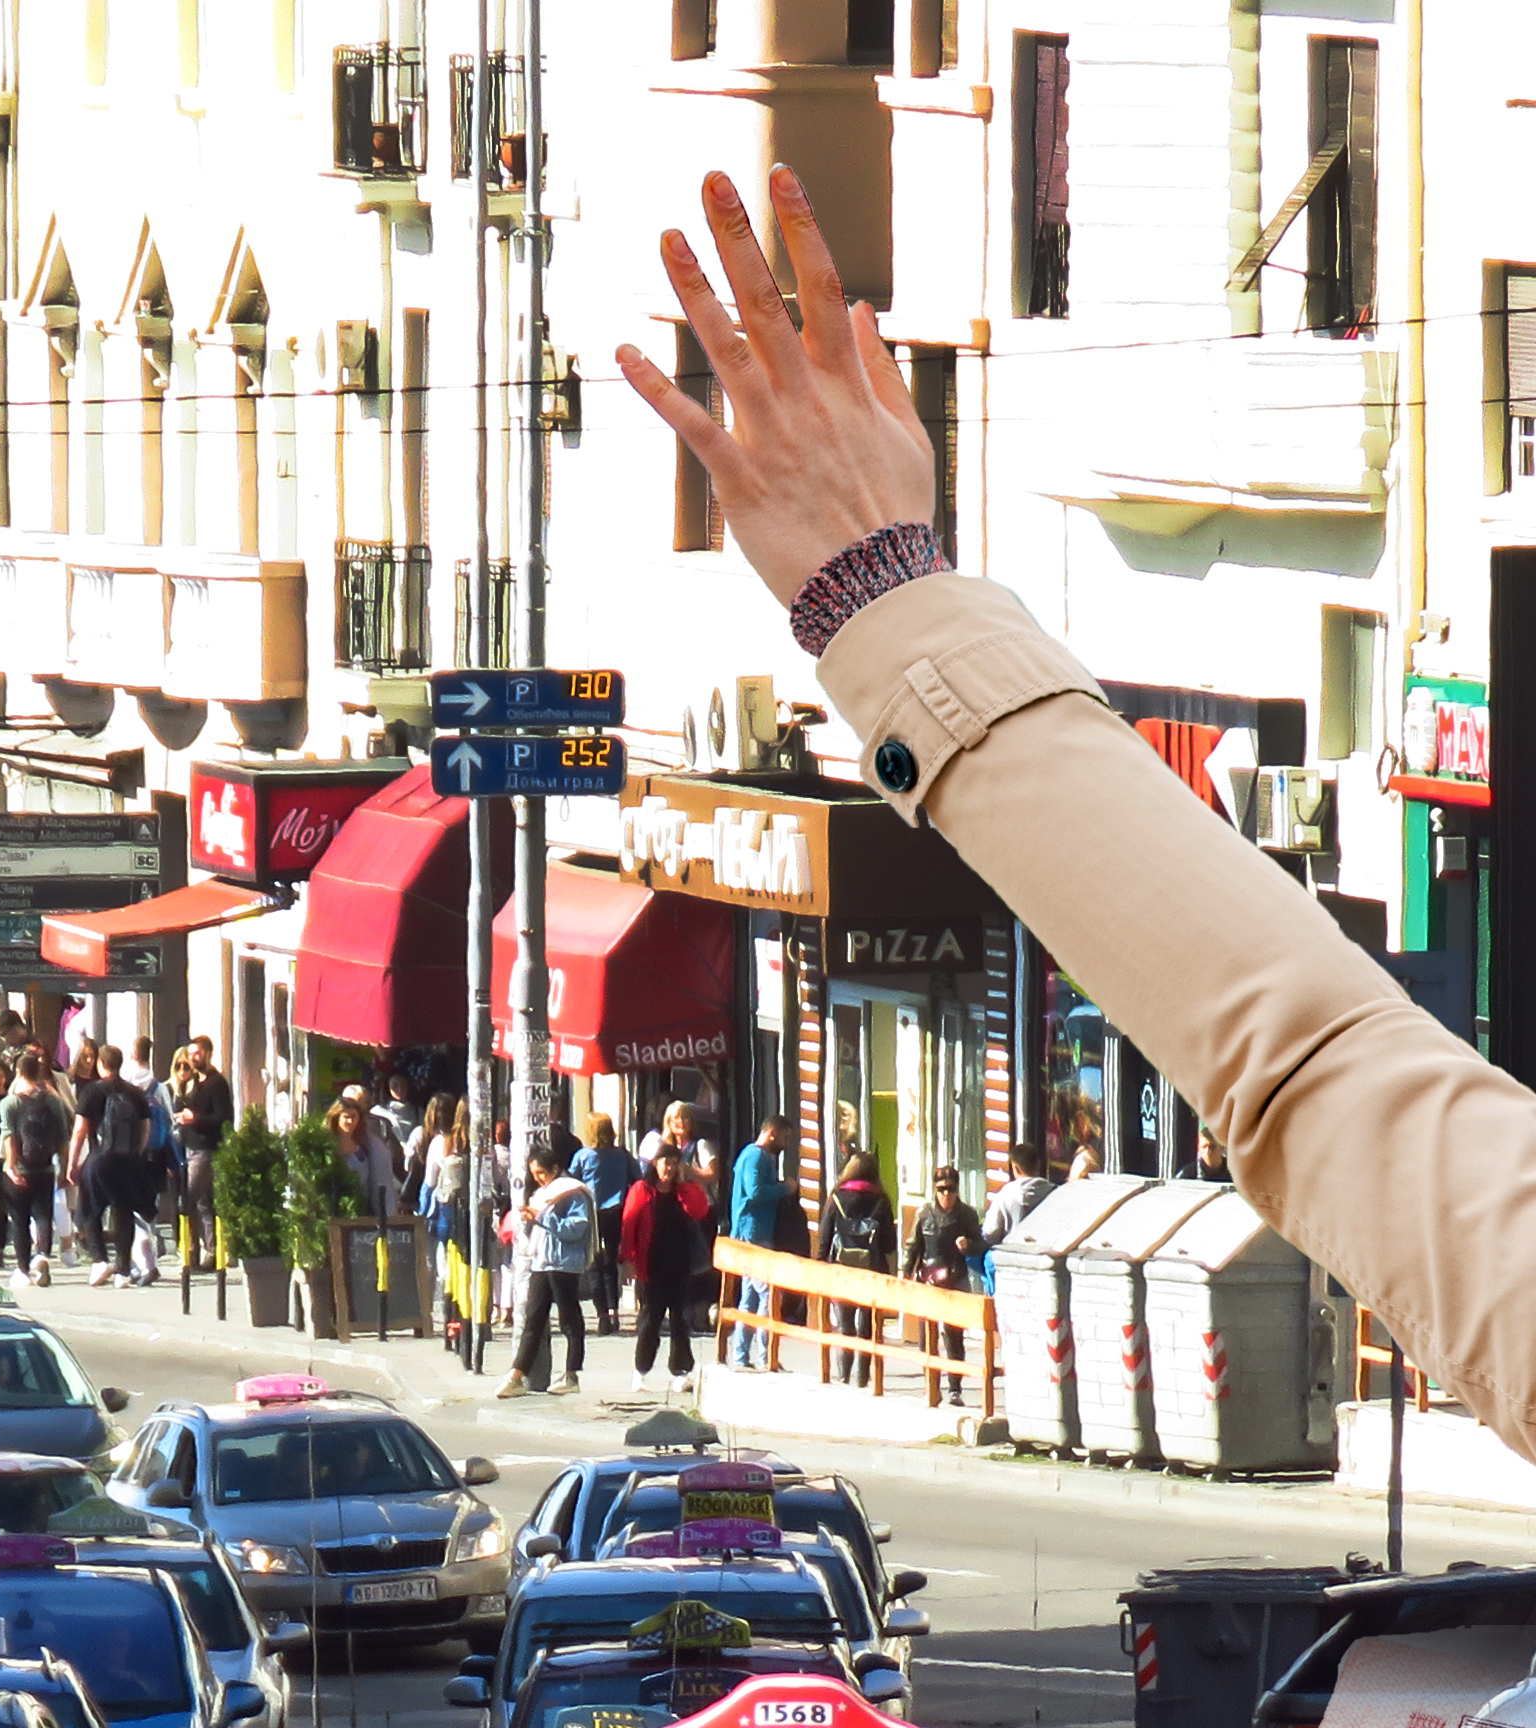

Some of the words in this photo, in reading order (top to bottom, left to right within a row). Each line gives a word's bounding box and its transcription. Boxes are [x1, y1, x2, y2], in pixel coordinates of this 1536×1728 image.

[570, 671, 612, 699] 130
[513, 743, 531, 767] P
[561, 739, 611, 767] 252
[504, 773, 558, 790] Доњи
[563, 777, 606, 791] град
[270, 806, 330, 855] Moj
[614, 1029, 729, 1068] Sladoled
[686, 1496, 770, 1515] BEOGRADSKI
[760, 1704, 827, 1724] 1568
